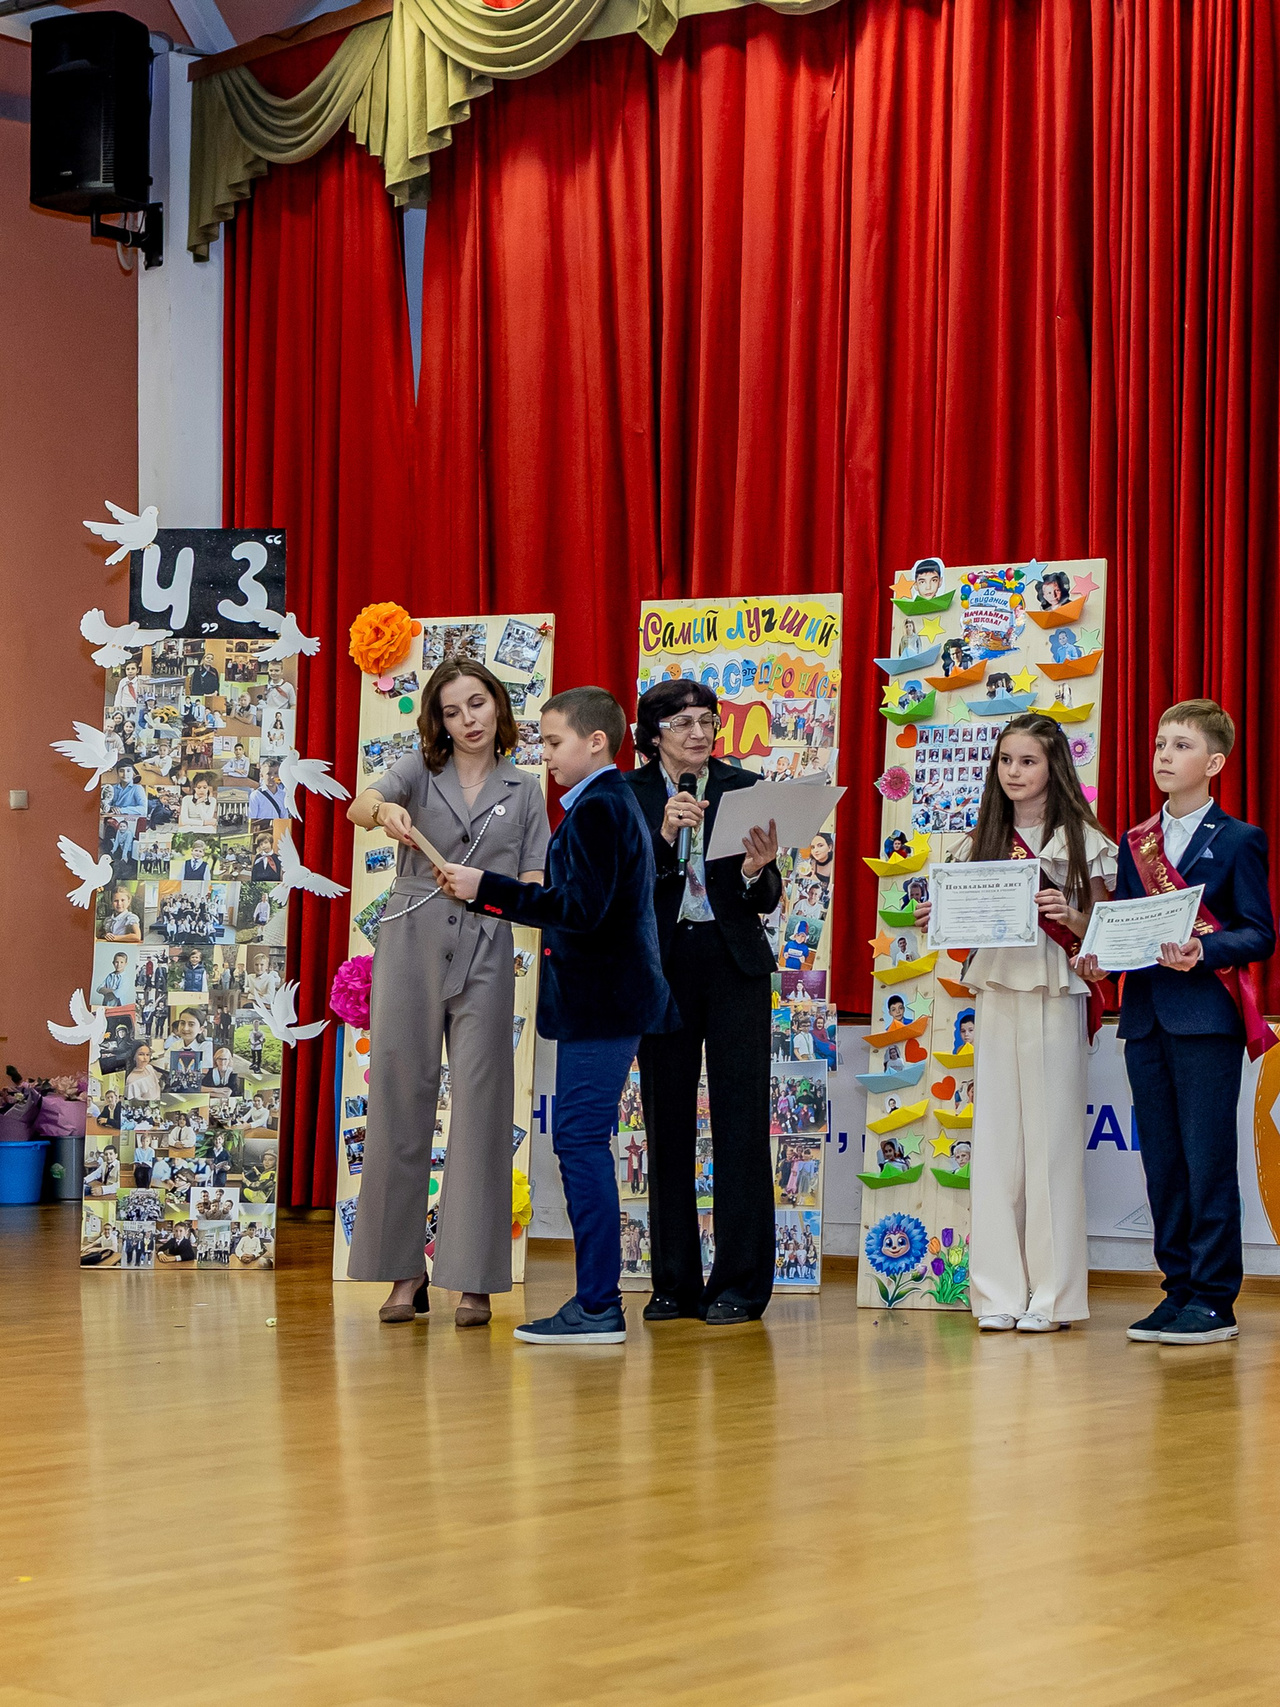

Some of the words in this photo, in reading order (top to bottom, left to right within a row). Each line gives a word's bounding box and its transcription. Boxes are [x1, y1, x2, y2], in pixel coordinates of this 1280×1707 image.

[963, 610, 1010, 622] НАЧАЛЬНАЯ
[973, 615, 1002, 627] ШКОЛА!
[642, 610, 719, 651] Самый
[758, 662, 795, 691] ПРО
